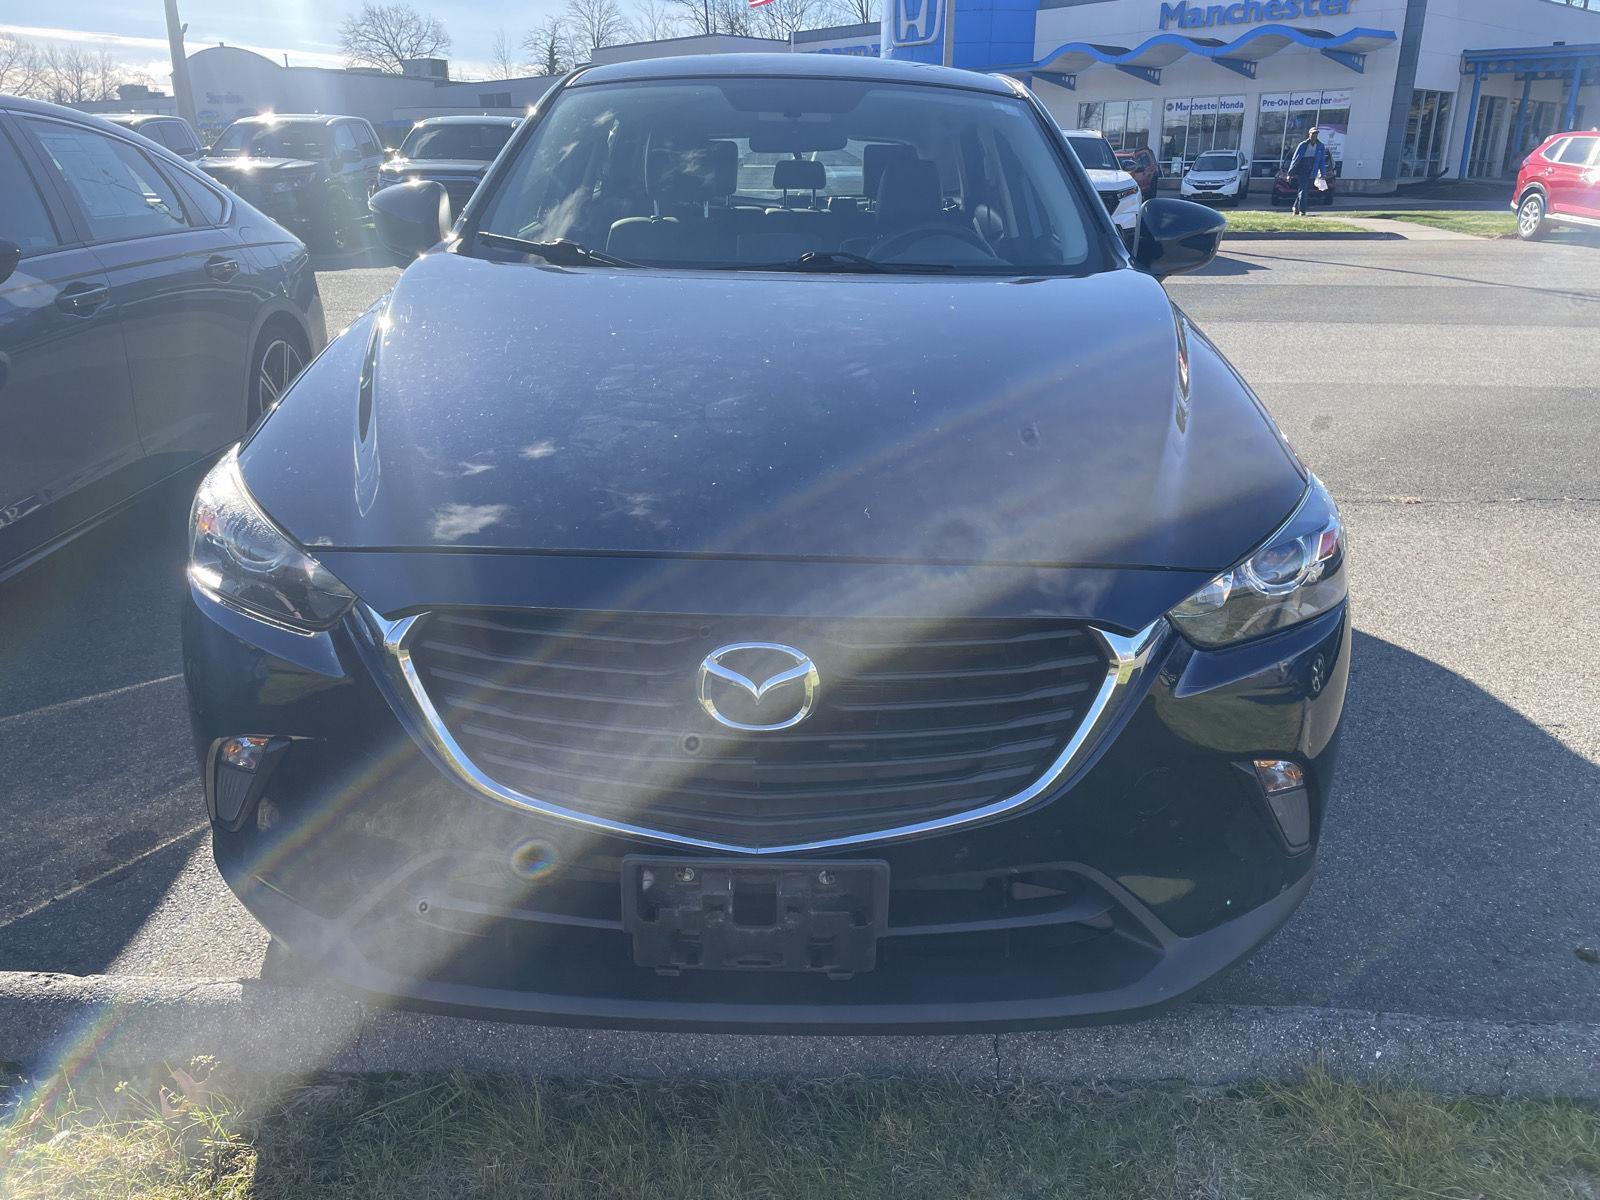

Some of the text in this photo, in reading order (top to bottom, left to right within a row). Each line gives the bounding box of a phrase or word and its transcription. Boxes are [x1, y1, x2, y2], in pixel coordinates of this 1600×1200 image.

[1159, 0, 1350, 30] Manchester
[1175, 101, 1244, 111] Manchester Honda
[1262, 98, 1304, 107] Pre-Owned
[1305, 97, 1332, 105] Center
